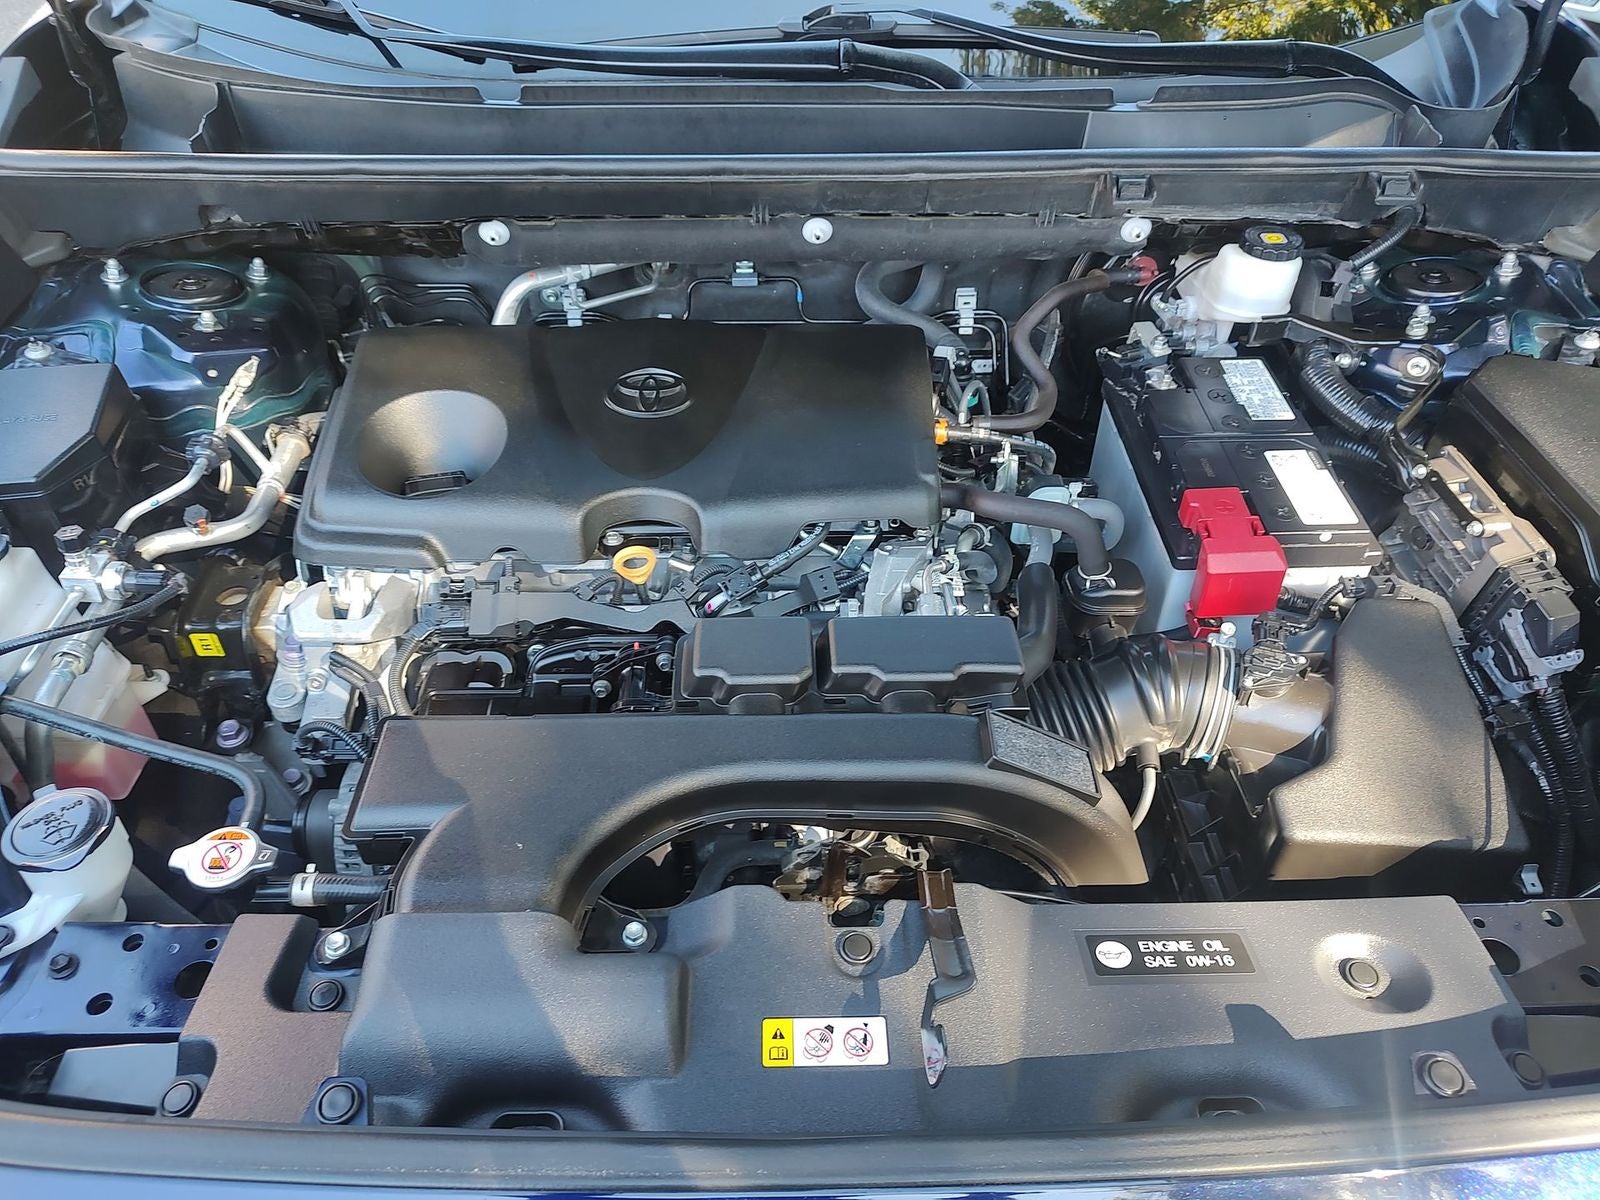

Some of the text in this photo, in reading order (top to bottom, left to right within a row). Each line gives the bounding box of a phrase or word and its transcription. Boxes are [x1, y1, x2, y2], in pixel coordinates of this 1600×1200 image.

[1137, 940, 1231, 953] ENGINE OIL
[1144, 955, 1236, 968] SAE 0W-16
